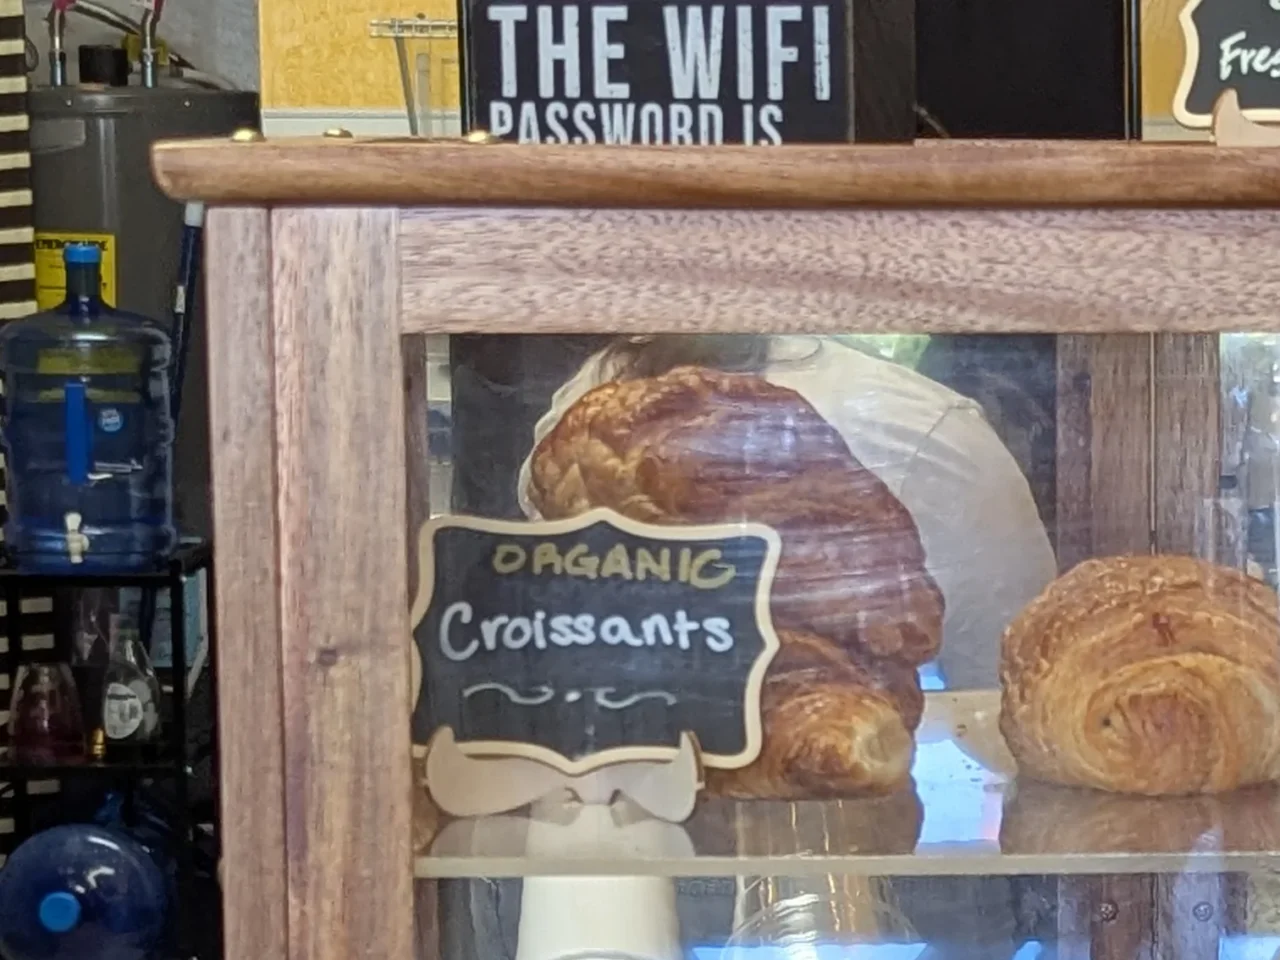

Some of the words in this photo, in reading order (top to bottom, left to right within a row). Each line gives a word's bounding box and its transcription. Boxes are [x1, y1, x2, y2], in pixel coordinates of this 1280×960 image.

[487, 4, 630, 99] THE
[662, 4, 831, 101] WIFI
[490, 100, 724, 145] PASSWORD
[743, 103, 784, 146] IS
[493, 541, 737, 590] ORGANIC
[440, 601, 735, 661] Croissants
